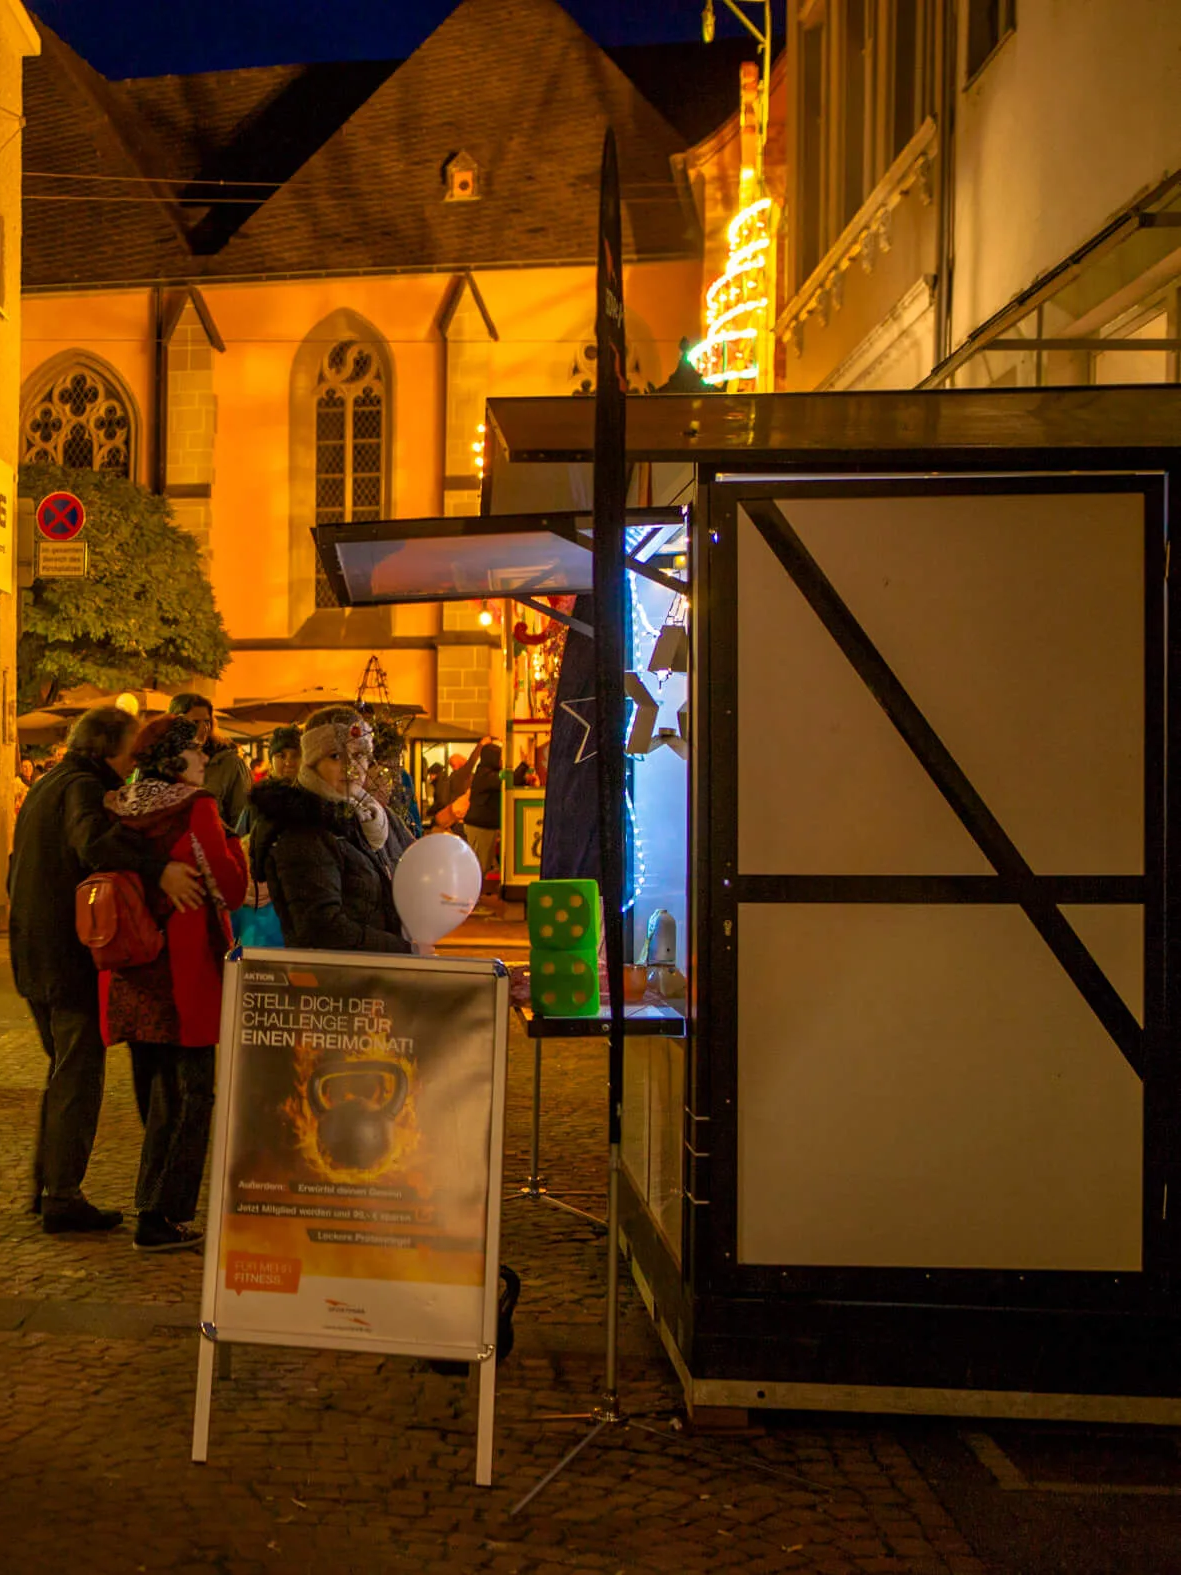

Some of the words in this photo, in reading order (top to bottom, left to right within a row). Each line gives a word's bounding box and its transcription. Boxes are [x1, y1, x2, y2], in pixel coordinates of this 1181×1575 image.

[243, 973, 275, 982] AKTION
[243, 992, 296, 1011] STELL
[300, 995, 343, 1013] DICH
[349, 998, 385, 1015] DER
[241, 1011, 348, 1032] CHALLENGE
[354, 1014, 392, 1034] FÜR
[241, 1029, 296, 1048] EINEN
[301, 1032, 414, 1054] FREIMONAT!
